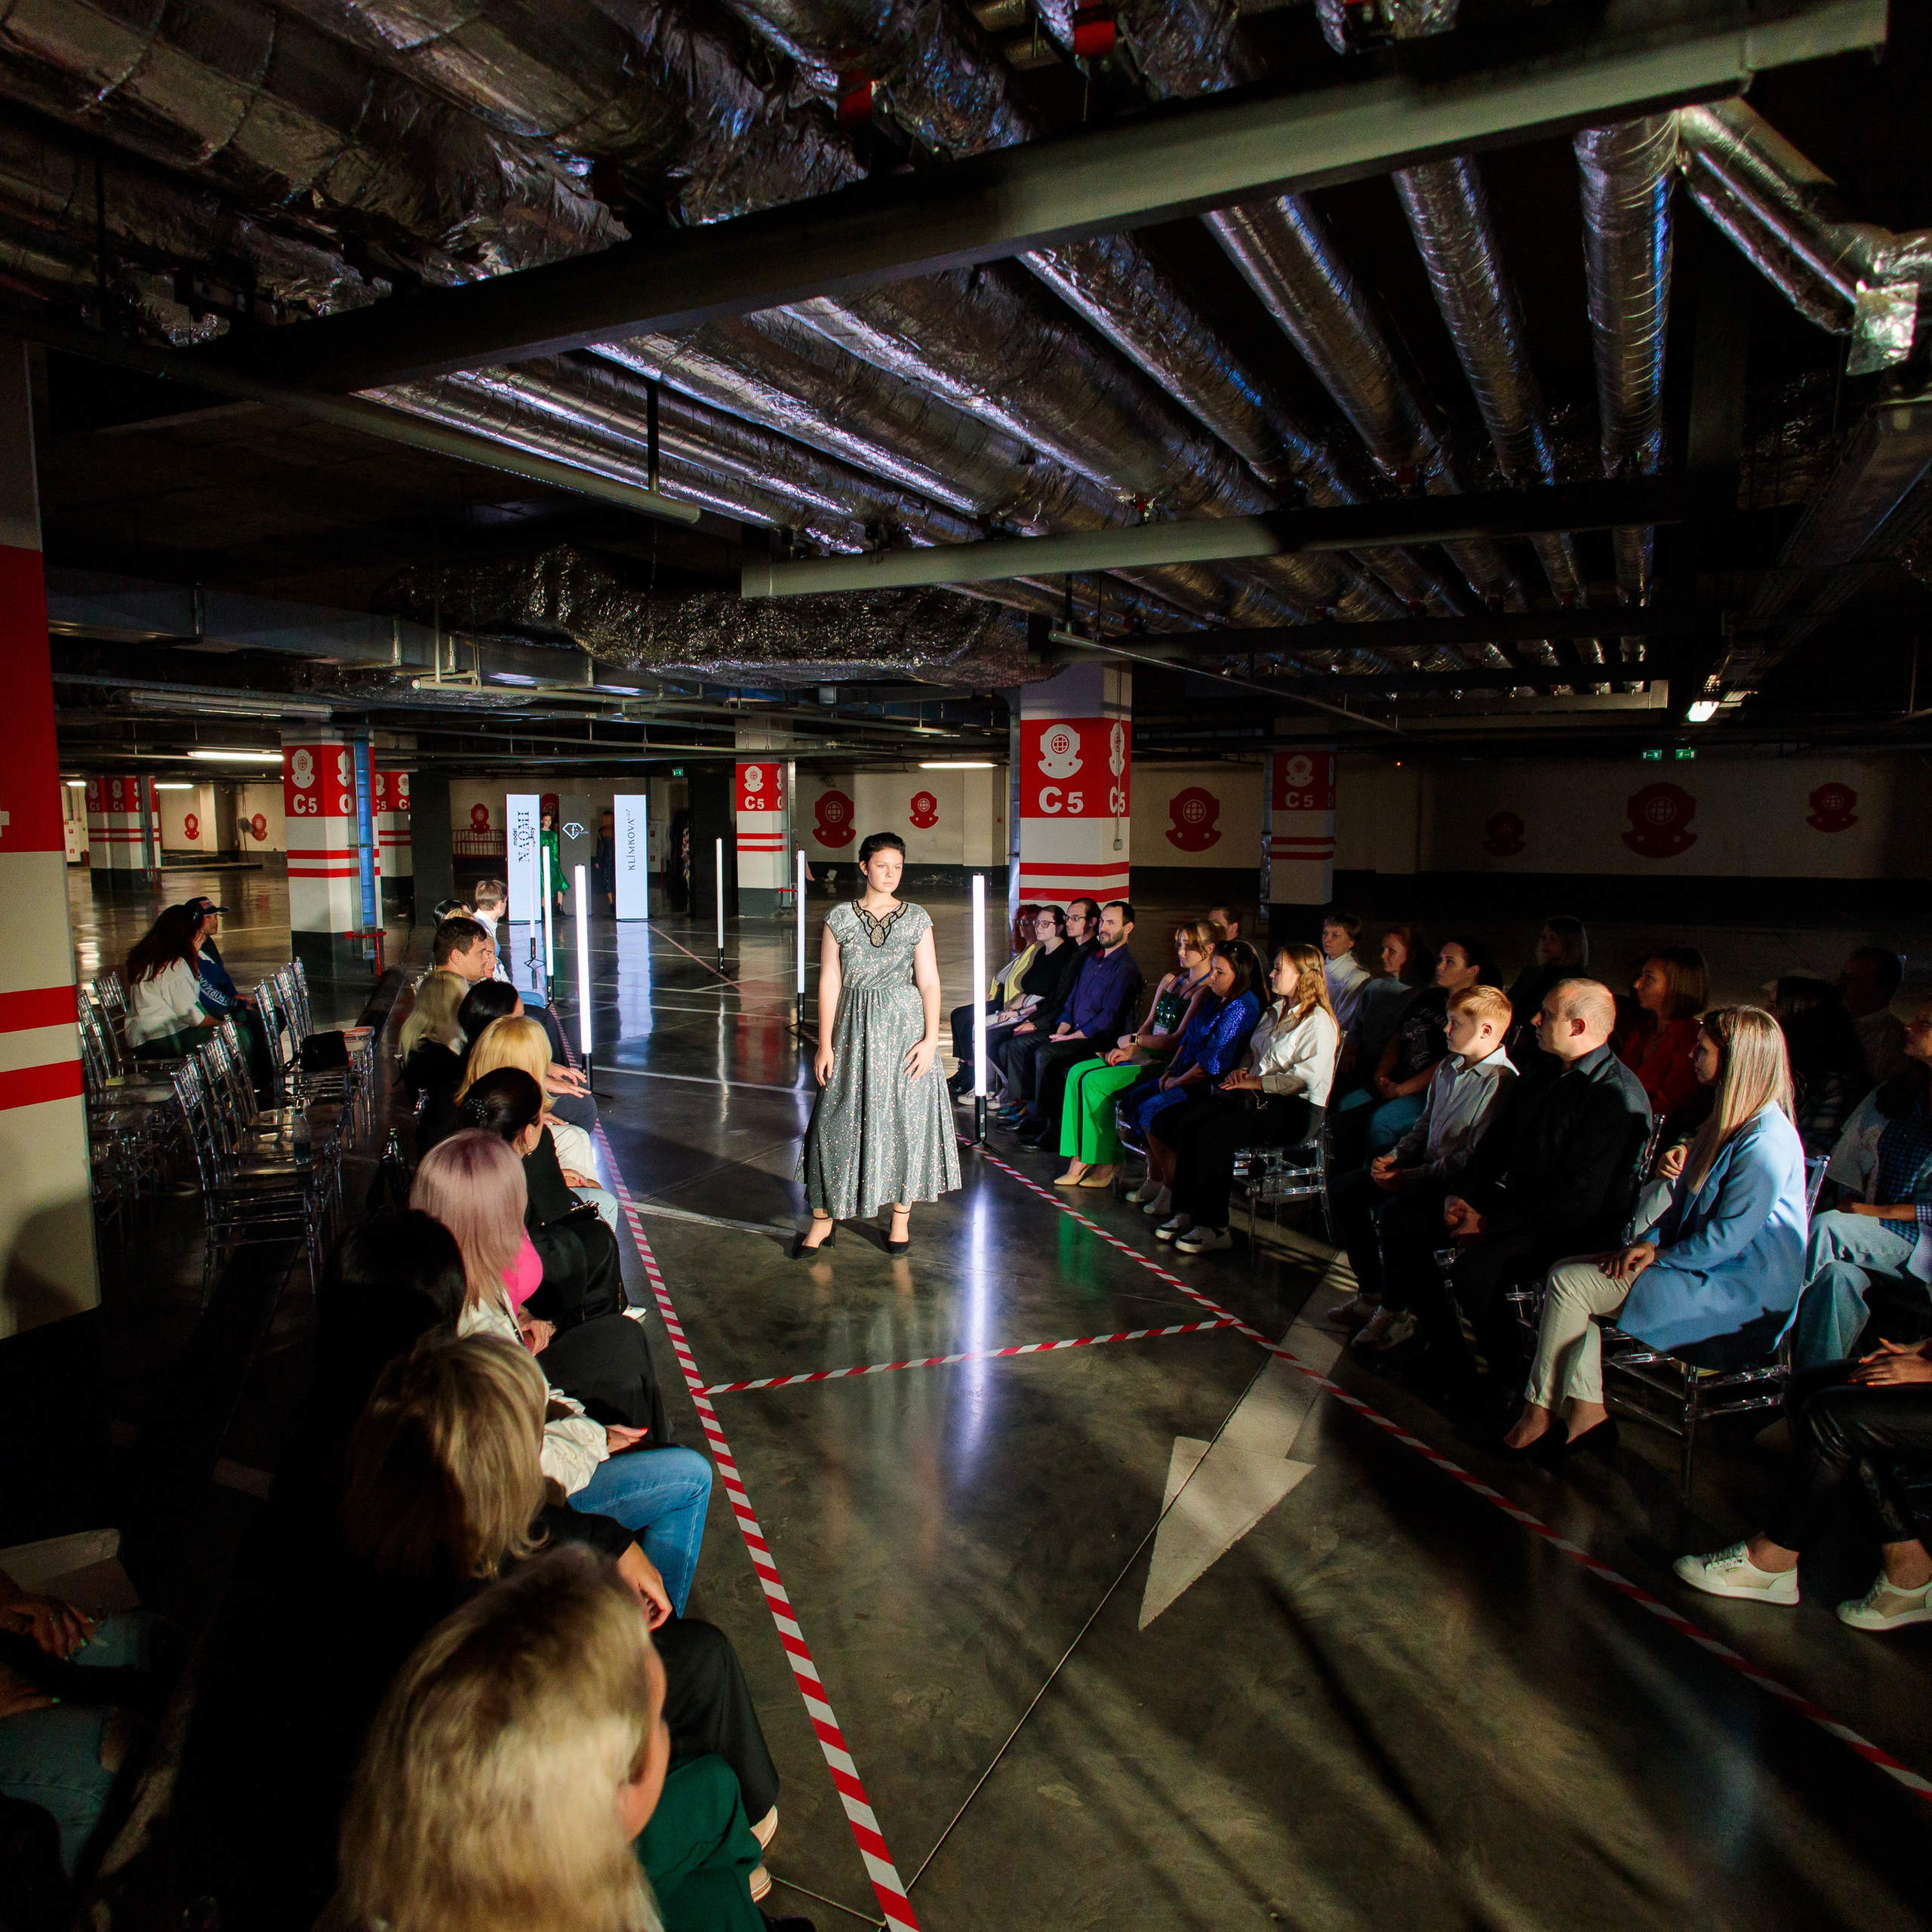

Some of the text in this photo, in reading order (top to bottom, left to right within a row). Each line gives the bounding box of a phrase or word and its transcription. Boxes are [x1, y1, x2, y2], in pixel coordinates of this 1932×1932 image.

[293, 793, 318, 814] C5
[744, 795, 765, 810] C5
[1038, 786, 1084, 814] C5
[1109, 786, 1126, 814] C5
[1285, 791, 1314, 808] C5
[517, 811, 530, 863] NAOMI
